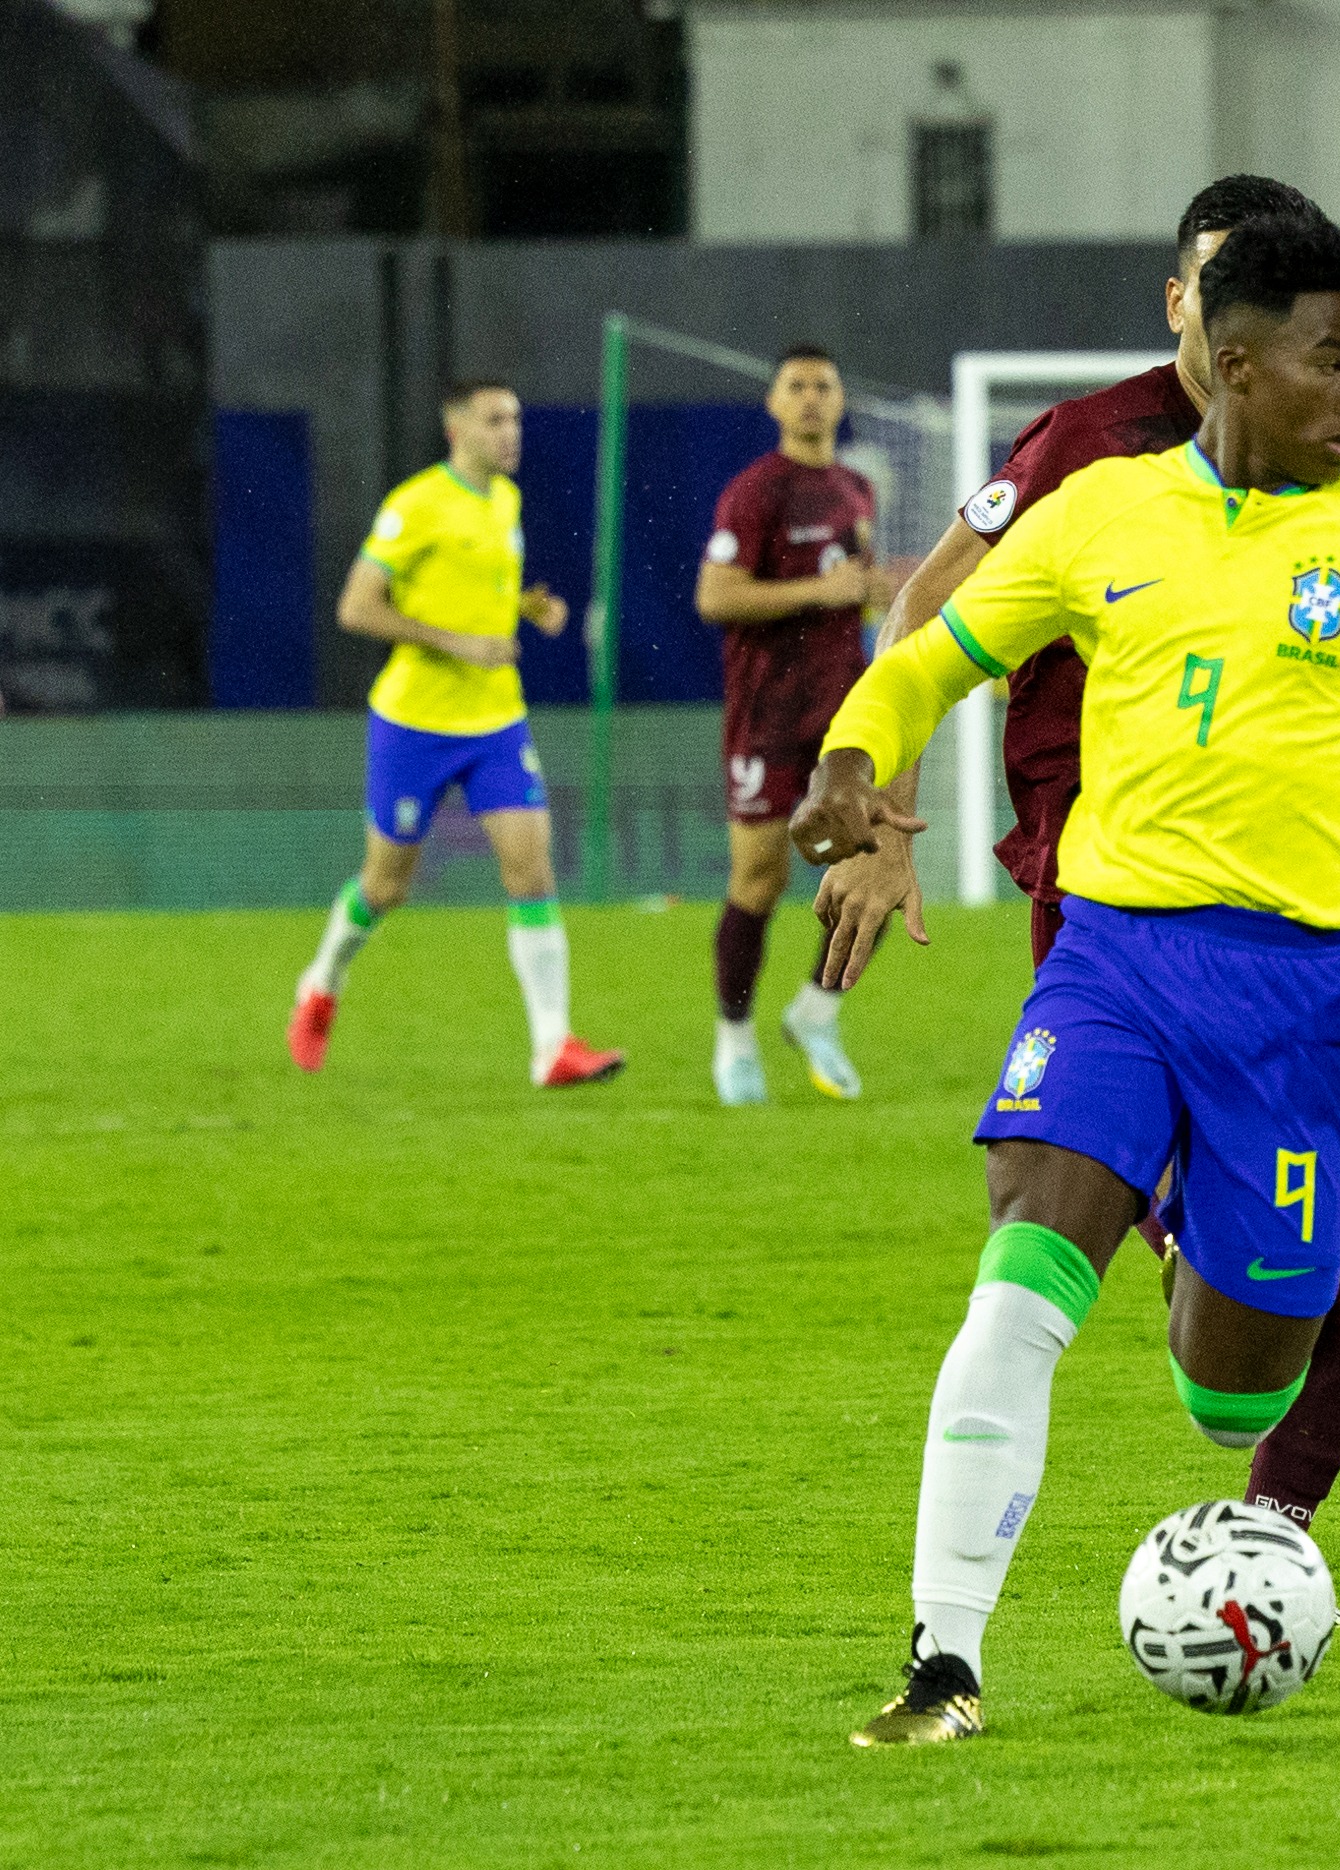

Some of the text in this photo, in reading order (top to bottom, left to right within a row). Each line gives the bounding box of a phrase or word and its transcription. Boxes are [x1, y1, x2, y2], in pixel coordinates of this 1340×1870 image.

[1177, 653, 1224, 747] 9
[1277, 644, 1337, 668] BRASIL
[1275, 1148, 1317, 1243] 9
